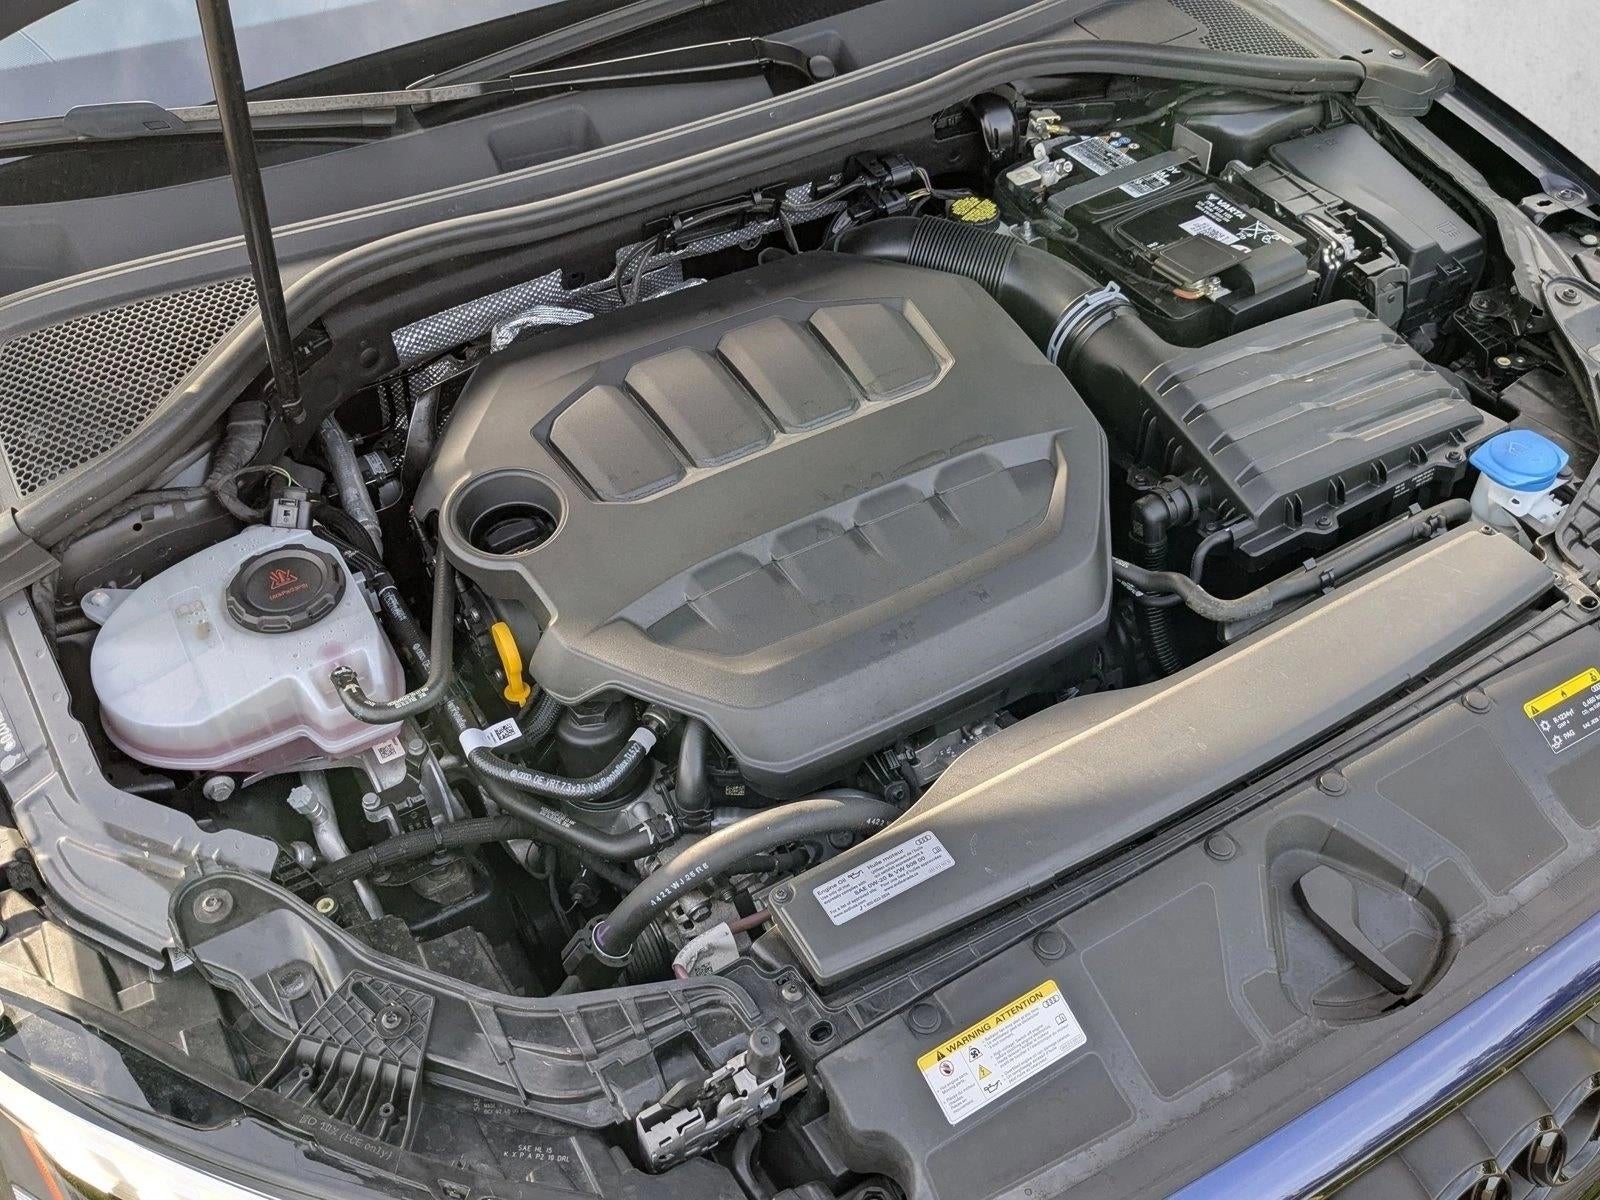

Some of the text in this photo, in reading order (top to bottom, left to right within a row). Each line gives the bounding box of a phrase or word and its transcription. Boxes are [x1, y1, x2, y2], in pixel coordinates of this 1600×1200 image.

[1217, 200, 1246, 219] VARTA
[1562, 729, 1576, 740] PAG
[882, 848, 904, 862] moteur
[817, 877, 846, 896] Engine Oil
[854, 886, 867, 895] SAE
[894, 866, 905, 874] VW
[945, 1022, 991, 1053] WARNING
[994, 991, 1044, 1024] ATTENTION
